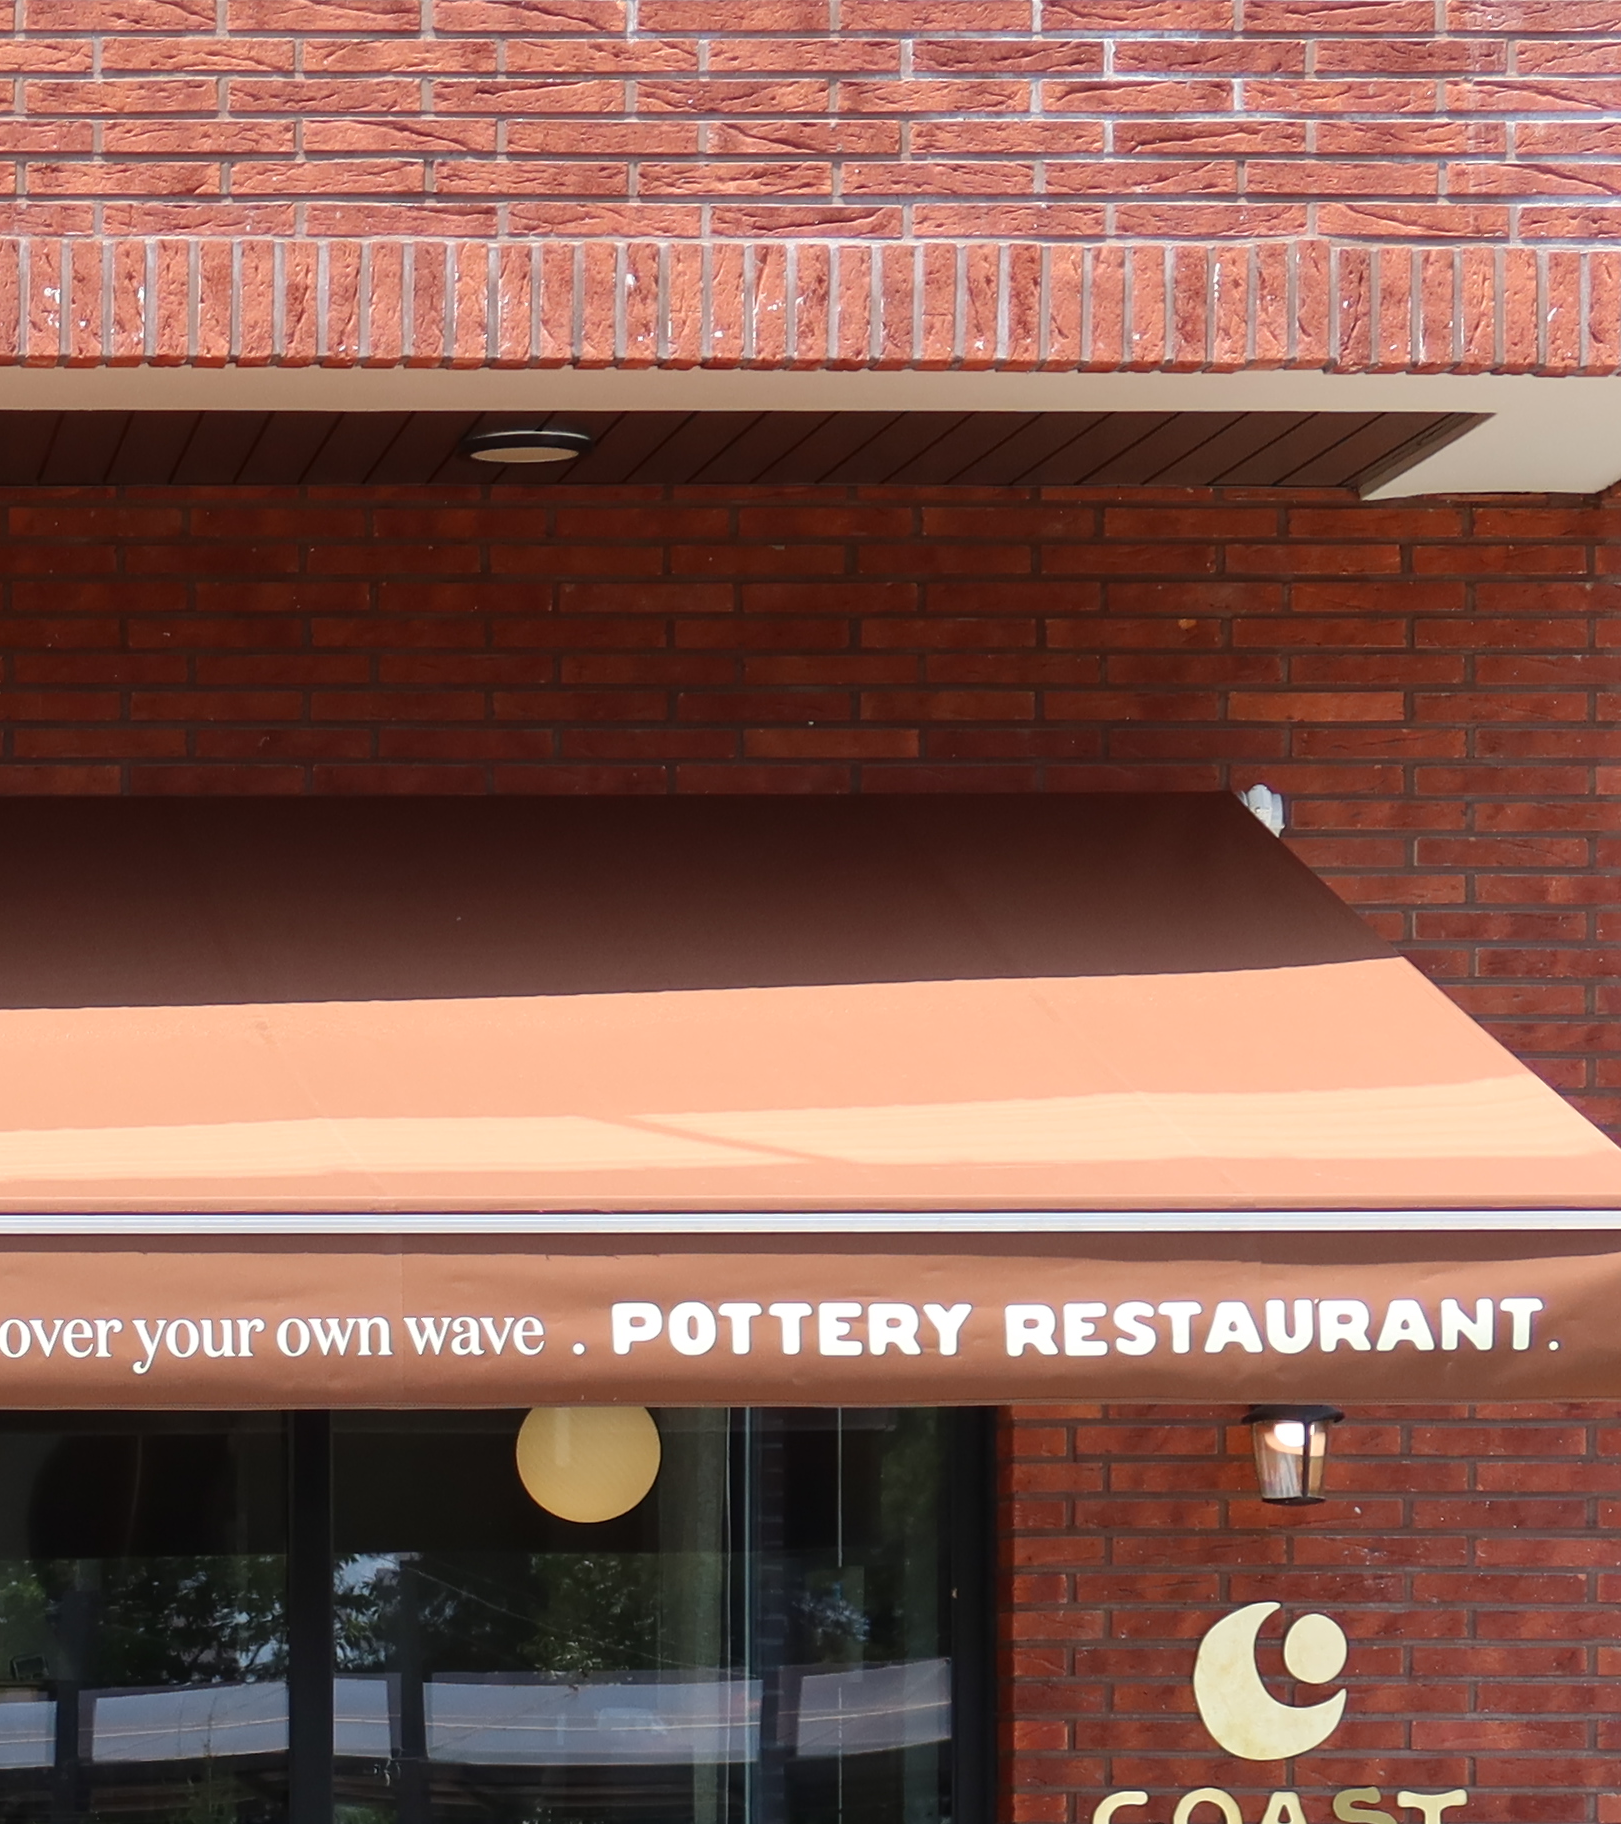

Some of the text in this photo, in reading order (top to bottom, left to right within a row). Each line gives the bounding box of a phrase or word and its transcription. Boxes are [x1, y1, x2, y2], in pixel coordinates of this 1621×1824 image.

[133, 1314, 265, 1374] your
[276, 1315, 394, 1358] own
[405, 1314, 545, 1357] wave
[611, 1301, 973, 1357] POTTERY
[1003, 1297, 1560, 1357] RESTAURANT.
